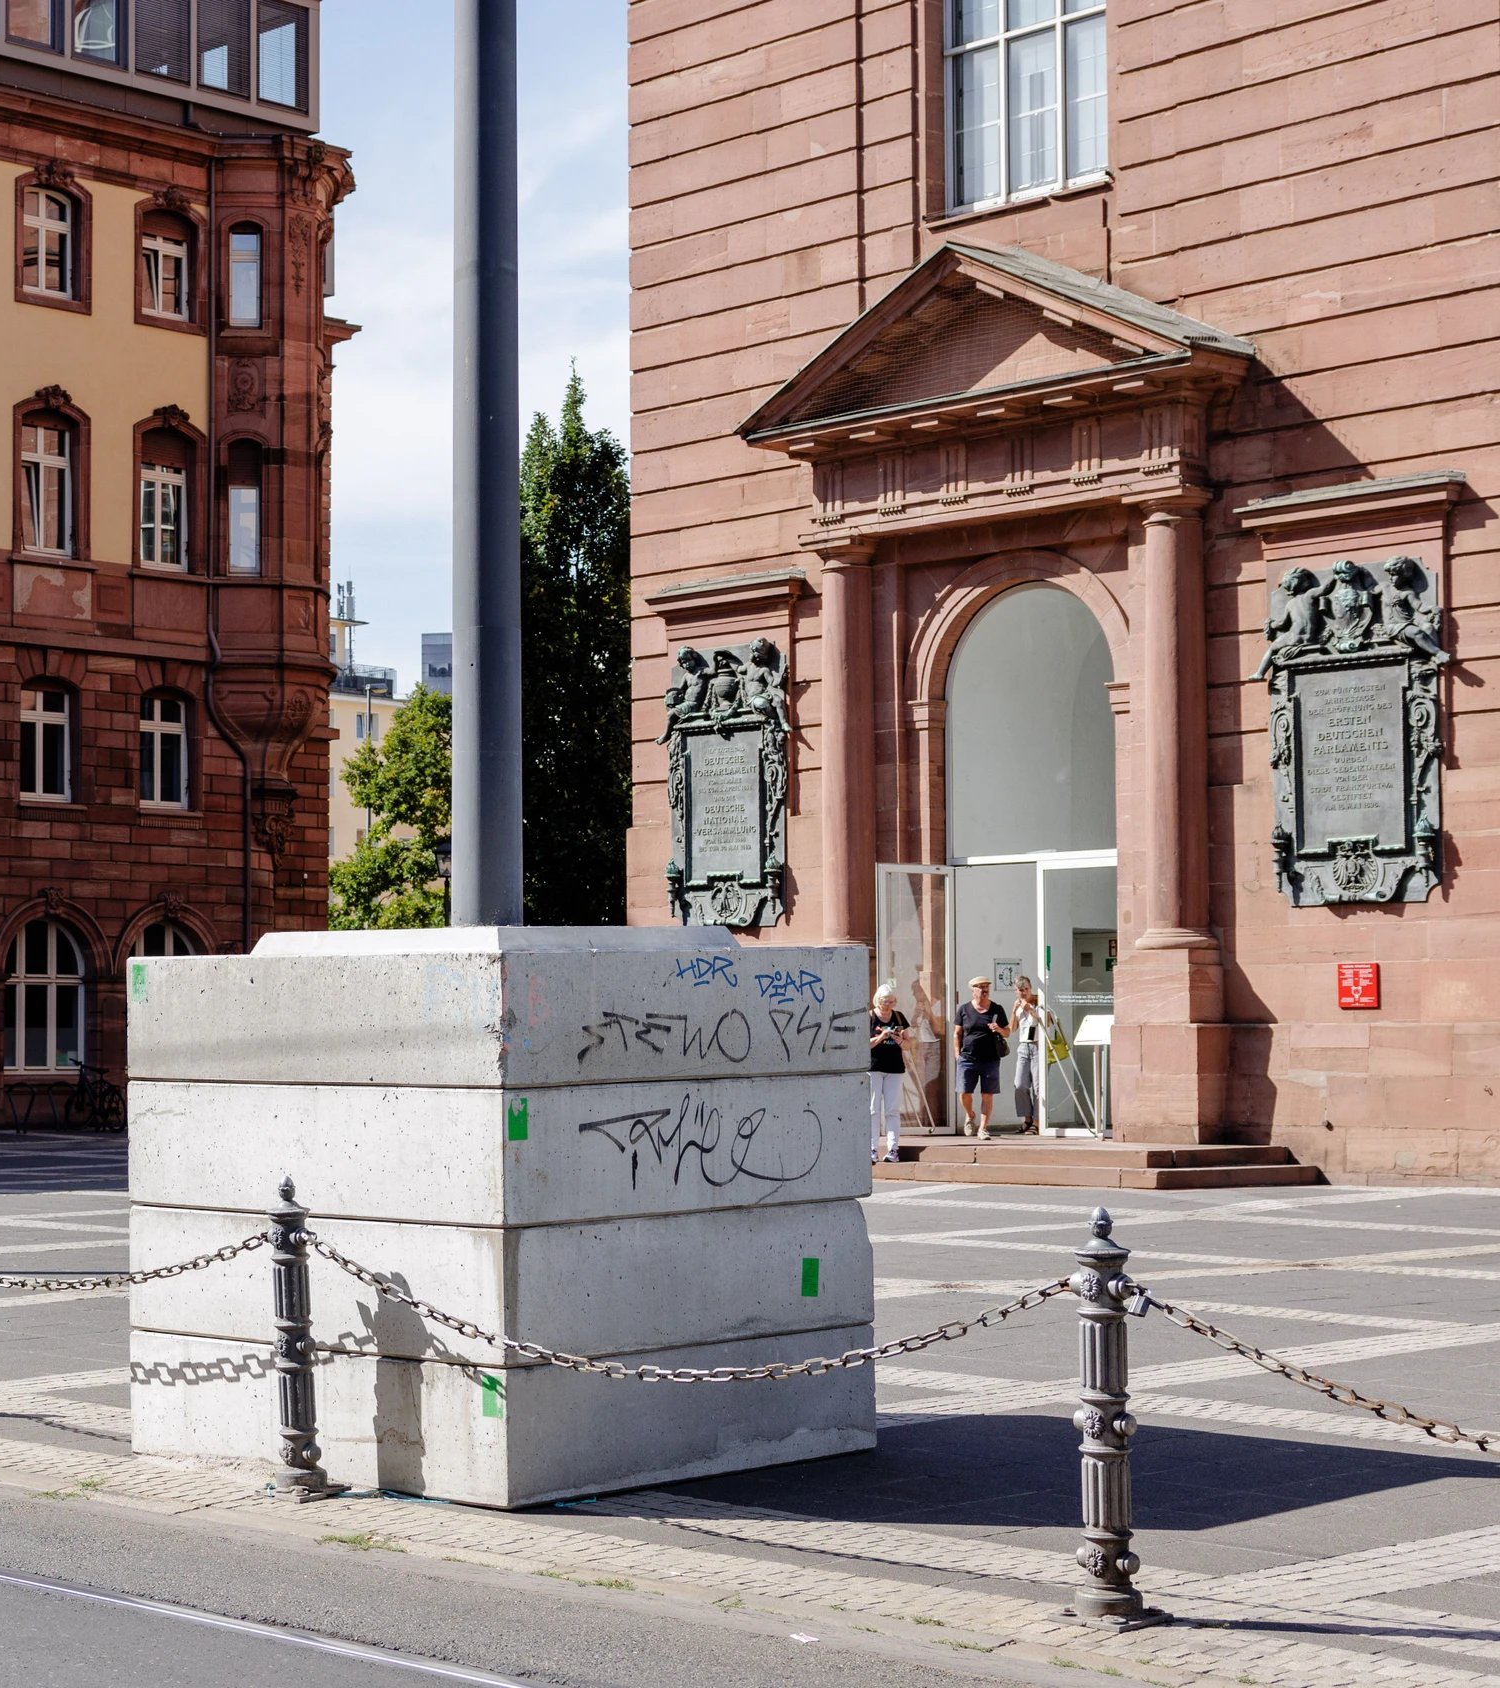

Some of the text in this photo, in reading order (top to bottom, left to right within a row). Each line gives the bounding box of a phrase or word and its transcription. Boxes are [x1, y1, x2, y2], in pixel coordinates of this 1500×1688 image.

[1324, 694, 1376, 706] JAHRESTAGE
[1308, 708, 1324, 717] DER
[1377, 702, 1393, 710] DES
[1329, 715, 1372, 728] ERSTEN
[1318, 727, 1384, 742] DEUTSCHEN
[1313, 740, 1389, 756] PARLAMENTS
[704, 755, 745, 766] DEUTSCHE
[1334, 755, 1368, 764] WURDEN
[693, 765, 757, 778] VORPARLAMENT
[1307, 762, 1396, 776] DIESE GEDENKTAFELN
[1335, 774, 1368, 783] VON DER
[1331, 792, 1373, 802] GESTIFTET
[704, 803, 746, 814] DEUTSCHE
[703, 815, 747, 826] NATIONAL-
